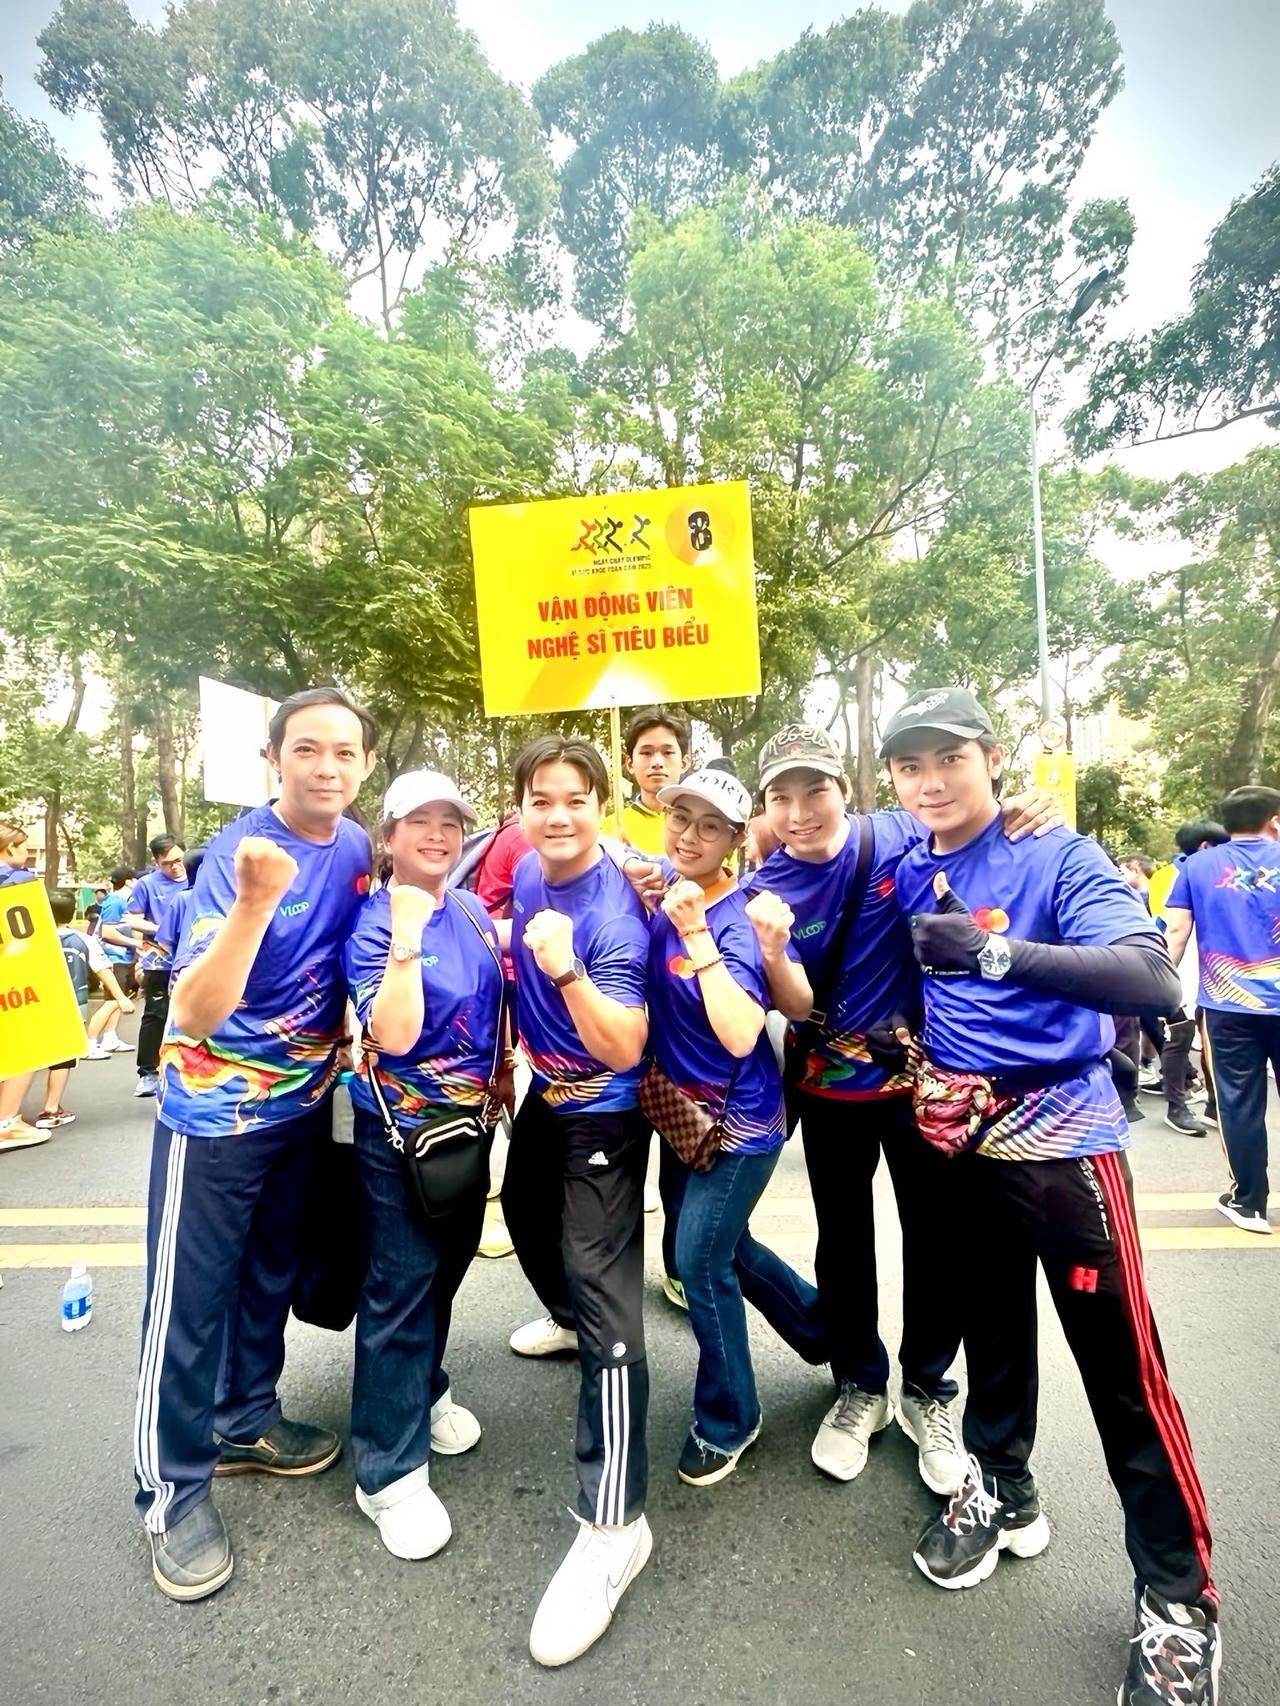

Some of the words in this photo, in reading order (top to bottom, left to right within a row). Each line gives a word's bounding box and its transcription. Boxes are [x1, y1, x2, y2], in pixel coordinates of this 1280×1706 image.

[687, 510, 713, 551] 8
[537, 596, 578, 625] VẬN
[584, 591, 641, 621] ĐỘNG
[646, 585, 693, 612] VIÊN
[527, 631, 580, 660] NGHỆ
[612, 625, 656, 652] TIÊU
[662, 616, 709, 648] BIỂU
[791, 920, 827, 940] VLOOP
